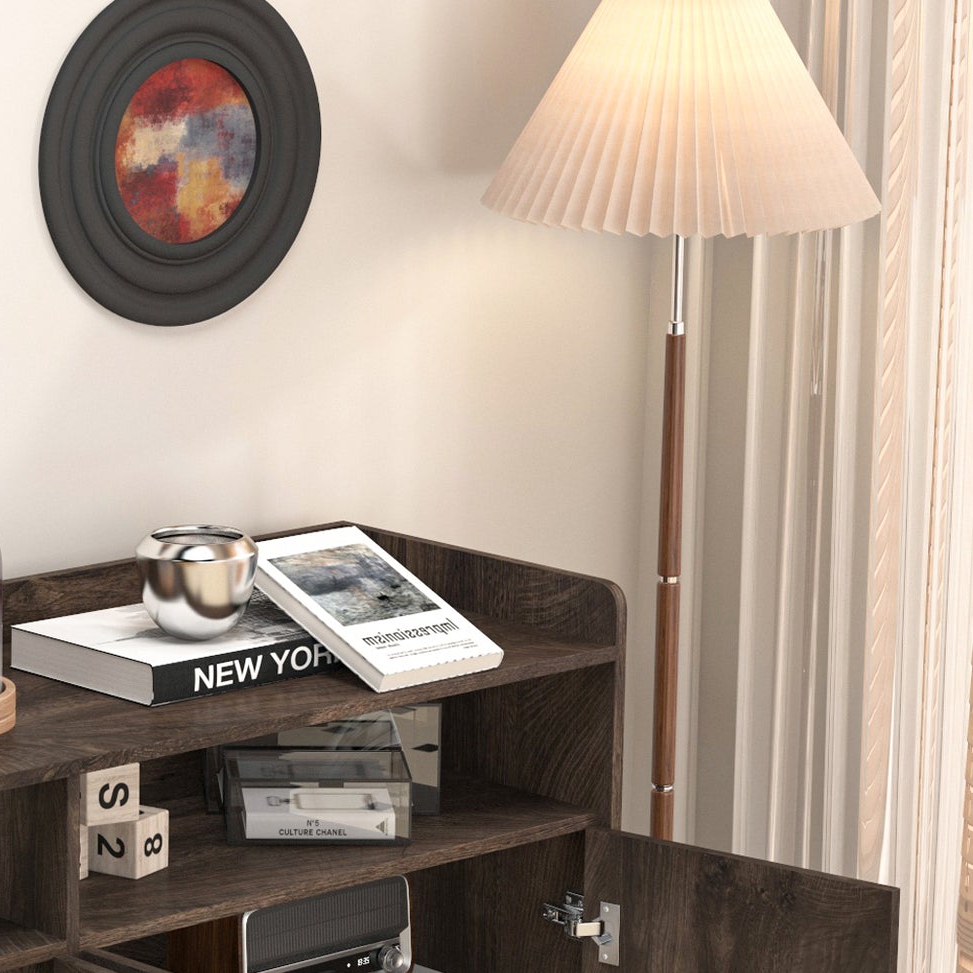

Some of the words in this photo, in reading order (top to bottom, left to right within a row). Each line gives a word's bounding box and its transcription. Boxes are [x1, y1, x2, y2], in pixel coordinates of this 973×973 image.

[193, 654, 263, 692] NEW
[270, 643, 340, 675] YOR
[98, 782, 129, 809] S
[278, 828, 314, 836] CULTURE
[315, 828, 347, 836] CHANEL
[97, 833, 125, 858] 2
[144, 833, 162, 857] 8
